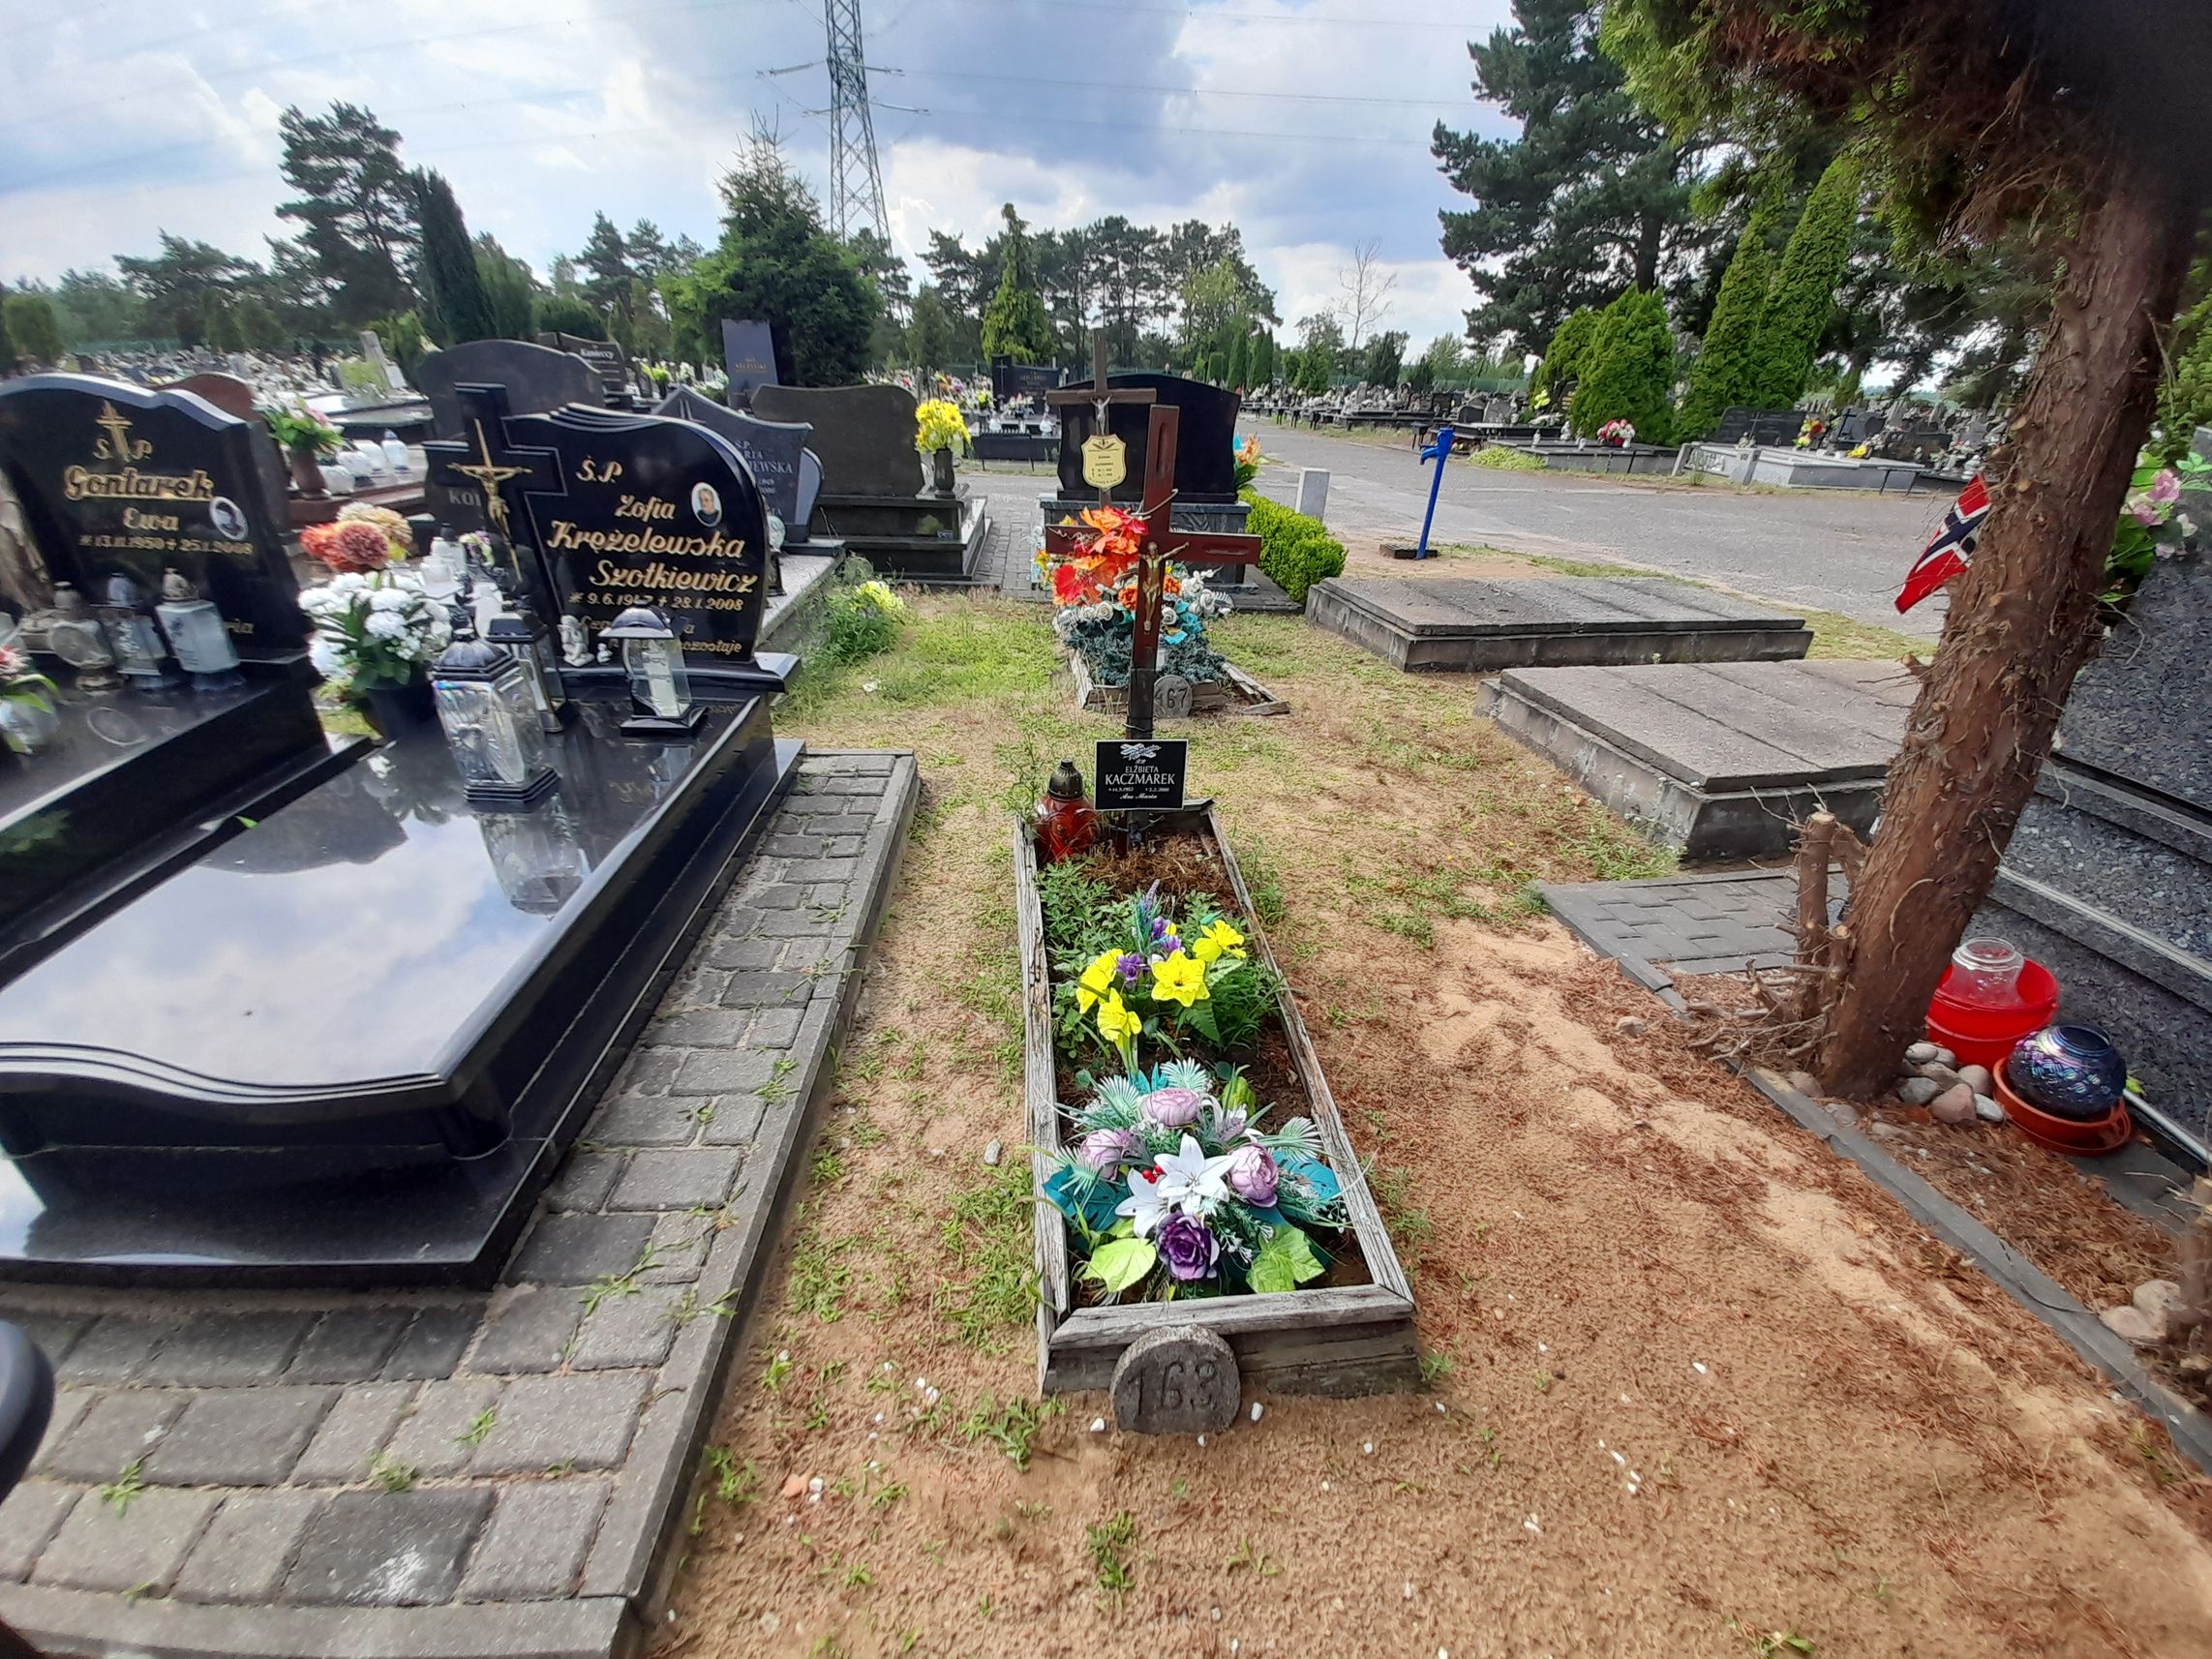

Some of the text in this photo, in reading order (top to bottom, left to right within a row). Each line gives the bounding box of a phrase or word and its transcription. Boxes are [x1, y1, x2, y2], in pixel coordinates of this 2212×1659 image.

[122, 506, 180, 531] Ewa
[614, 494, 677, 523] Zofia
[547, 519, 745, 559] Krężelewska
[680, 639, 742, 656] ozostaje
[1105, 773, 1175, 785] KACZMAREK
